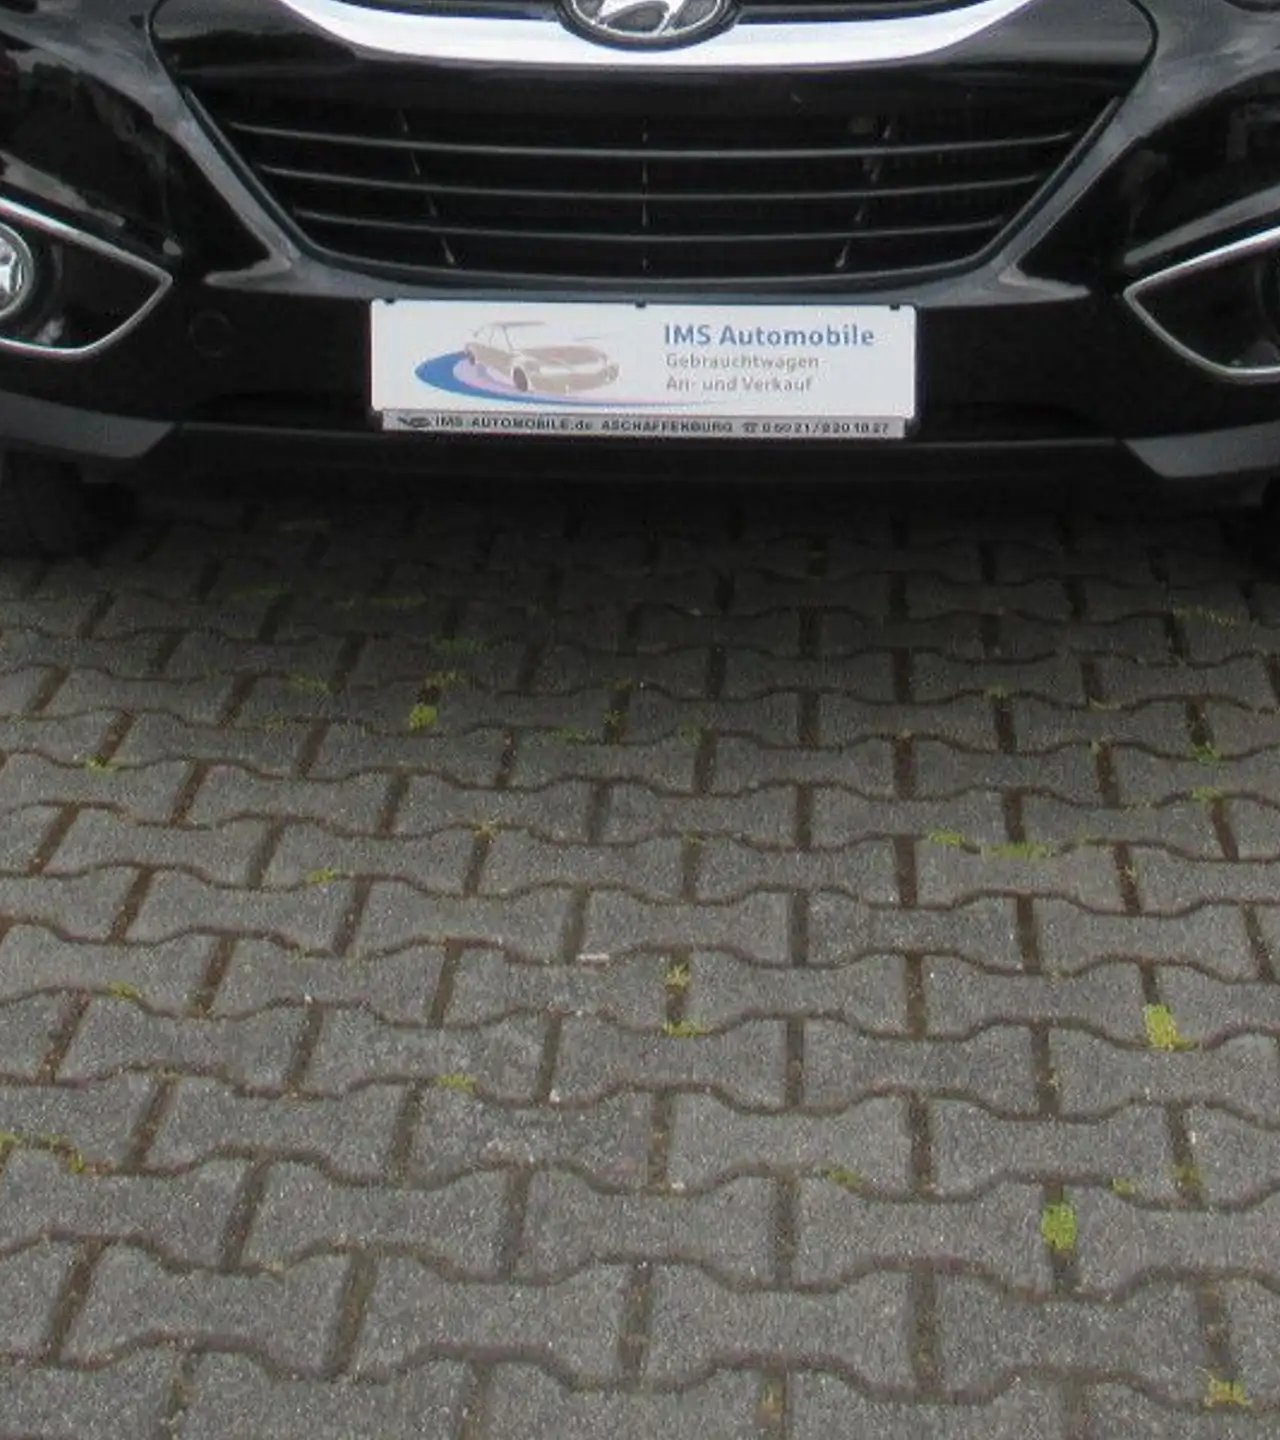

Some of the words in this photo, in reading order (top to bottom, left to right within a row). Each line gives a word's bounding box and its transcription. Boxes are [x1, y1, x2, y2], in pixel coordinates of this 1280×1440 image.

[664, 324, 711, 345] IMS
[719, 324, 875, 347] Automobile
[702, 376, 737, 392] und
[741, 375, 813, 393] Verkauf
[601, 419, 733, 434] ASCHAFFENBURG
